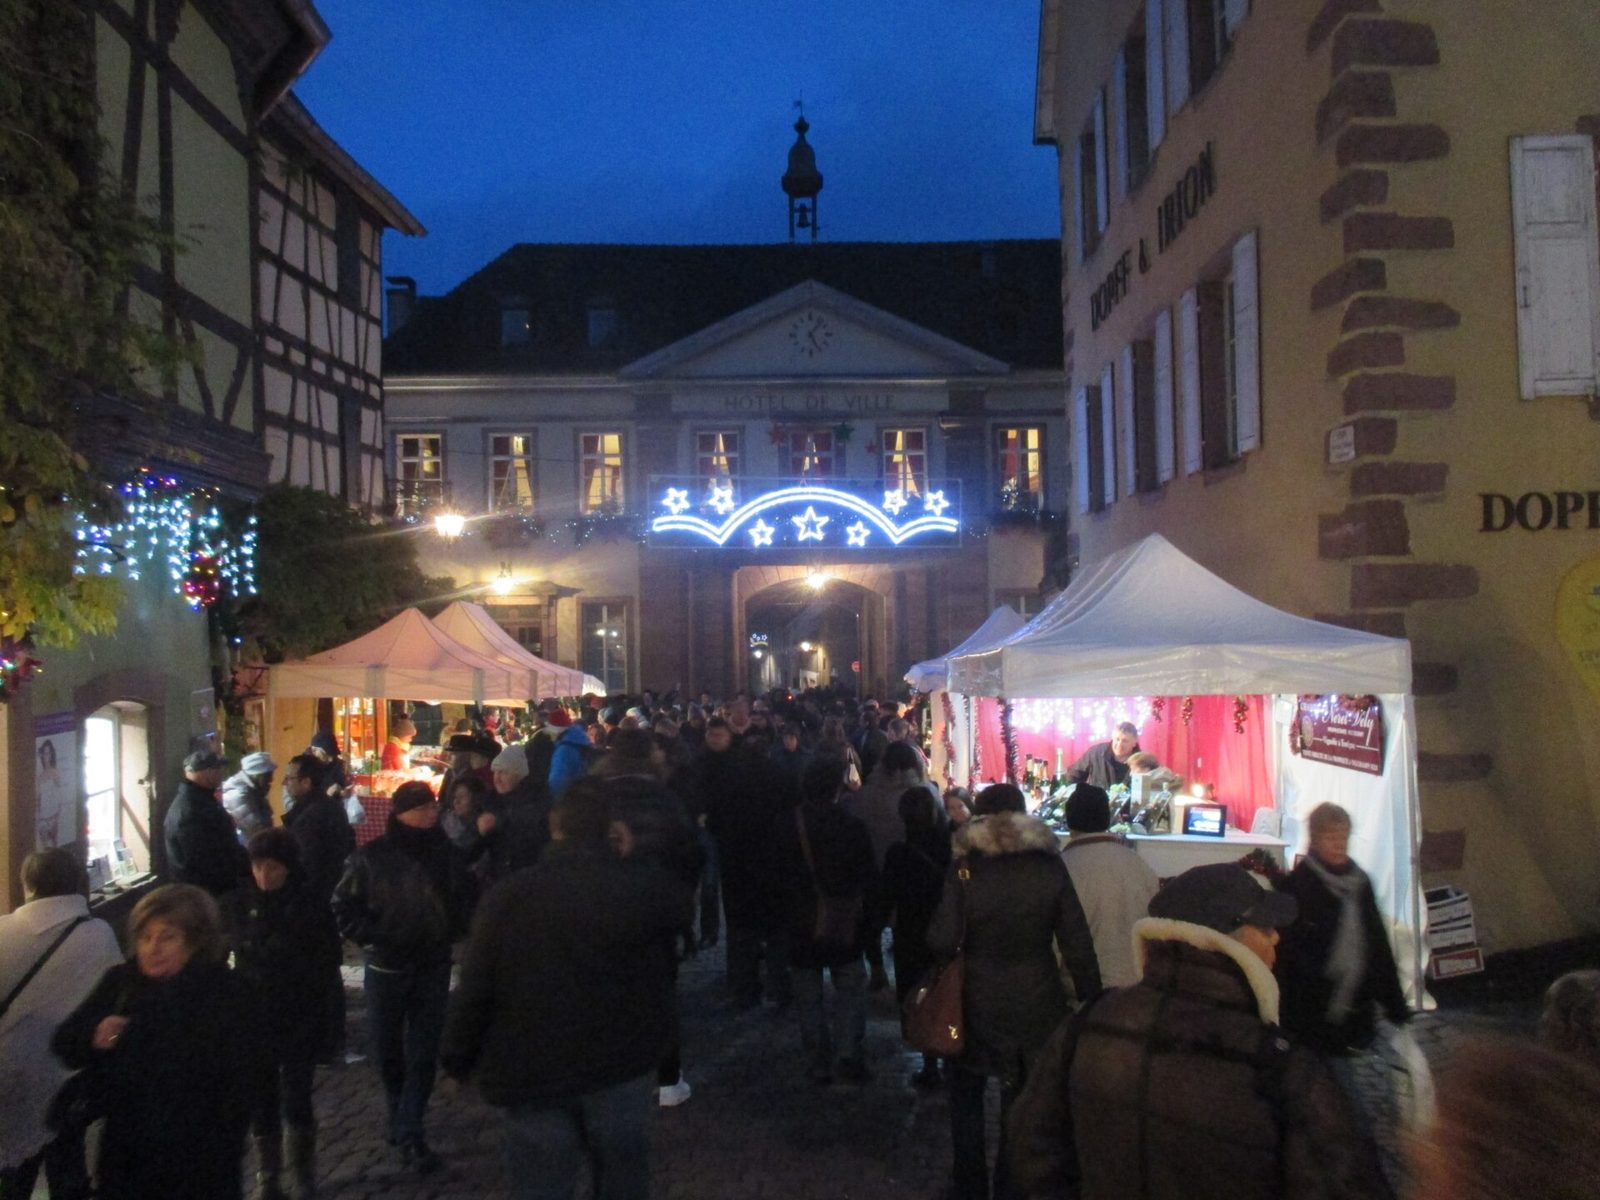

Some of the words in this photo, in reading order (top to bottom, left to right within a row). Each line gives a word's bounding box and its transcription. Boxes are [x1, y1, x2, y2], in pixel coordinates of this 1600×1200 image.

[1091, 249, 1132, 332] DOPFF
[1157, 140, 1216, 254] IRION
[805, 394, 828, 411] DE
[844, 393, 896, 411] VILLE
